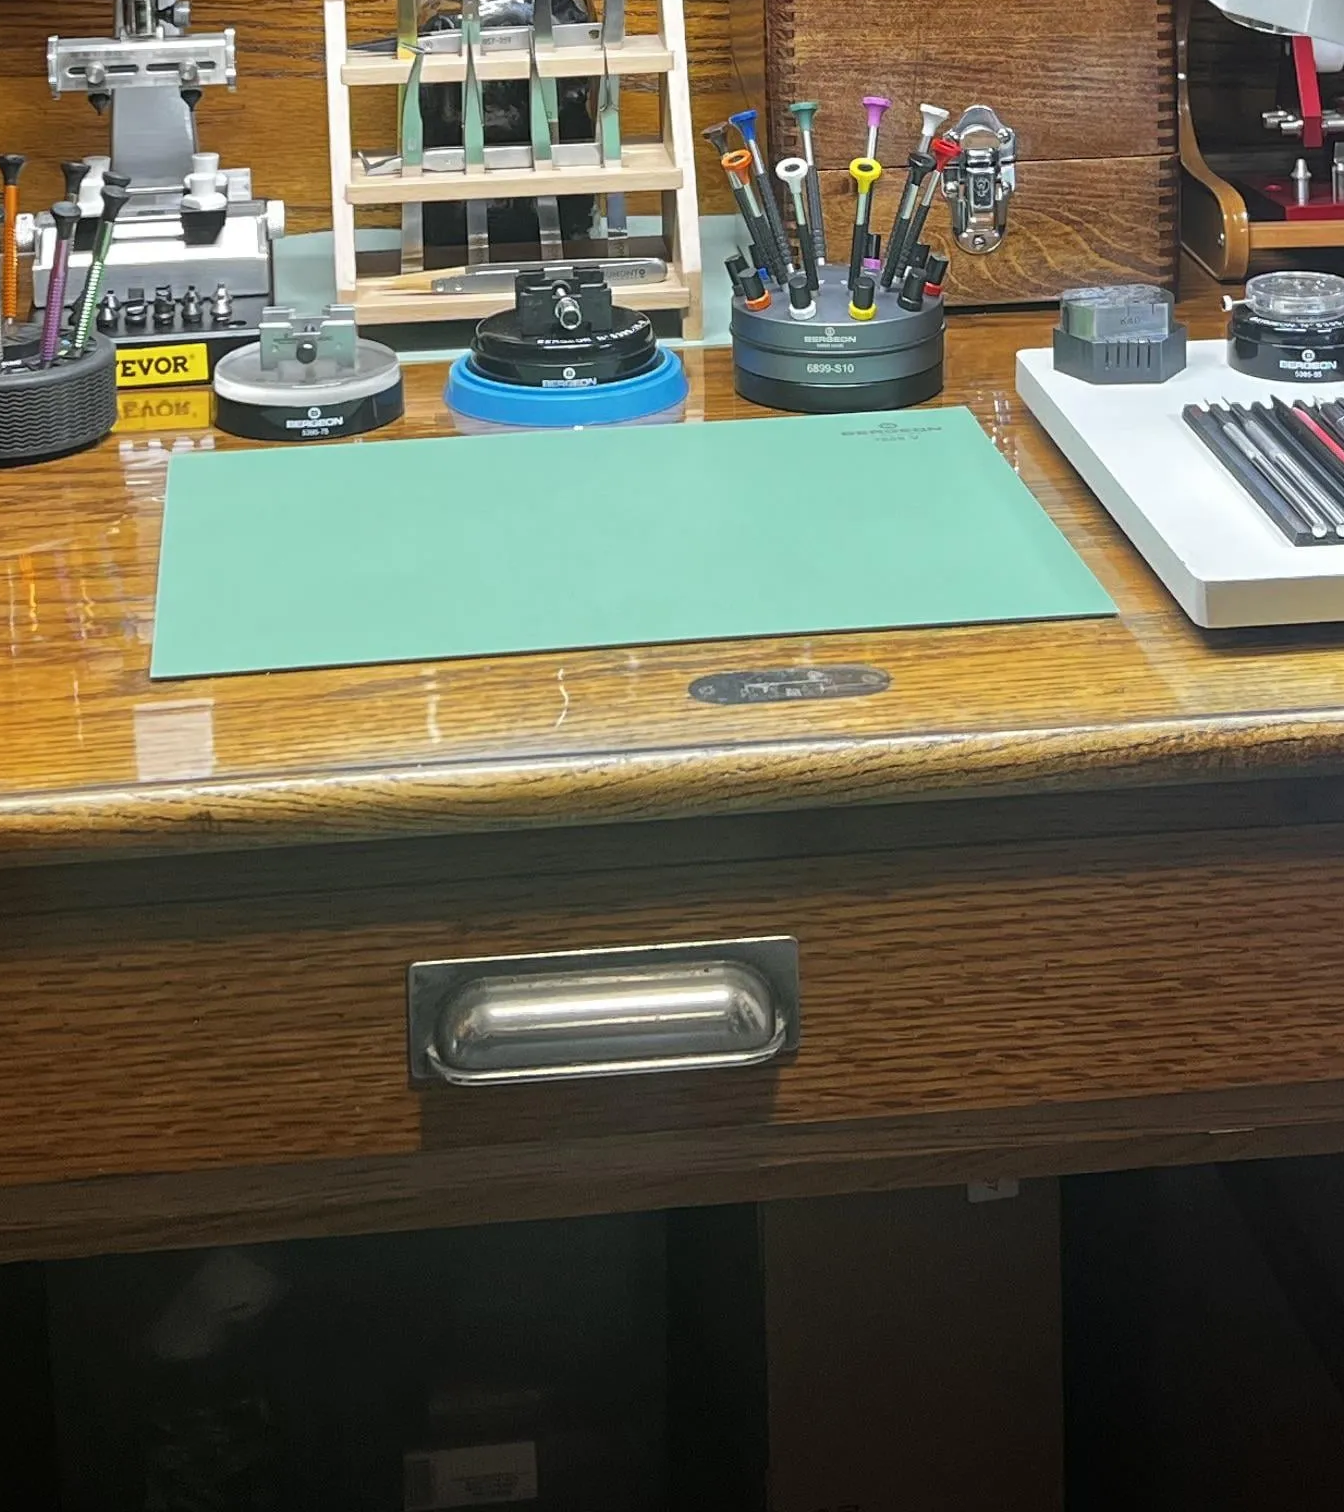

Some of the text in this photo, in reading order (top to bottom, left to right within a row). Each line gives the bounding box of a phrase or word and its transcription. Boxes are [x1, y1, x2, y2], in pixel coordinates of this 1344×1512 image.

[115, 355, 189, 378] EVOR
[807, 363, 855, 374] 6899-S10
[1279, 360, 1337, 370] BERGEON
[542, 377, 598, 388] BERGEON
[286, 415, 344, 429] BERGEON
